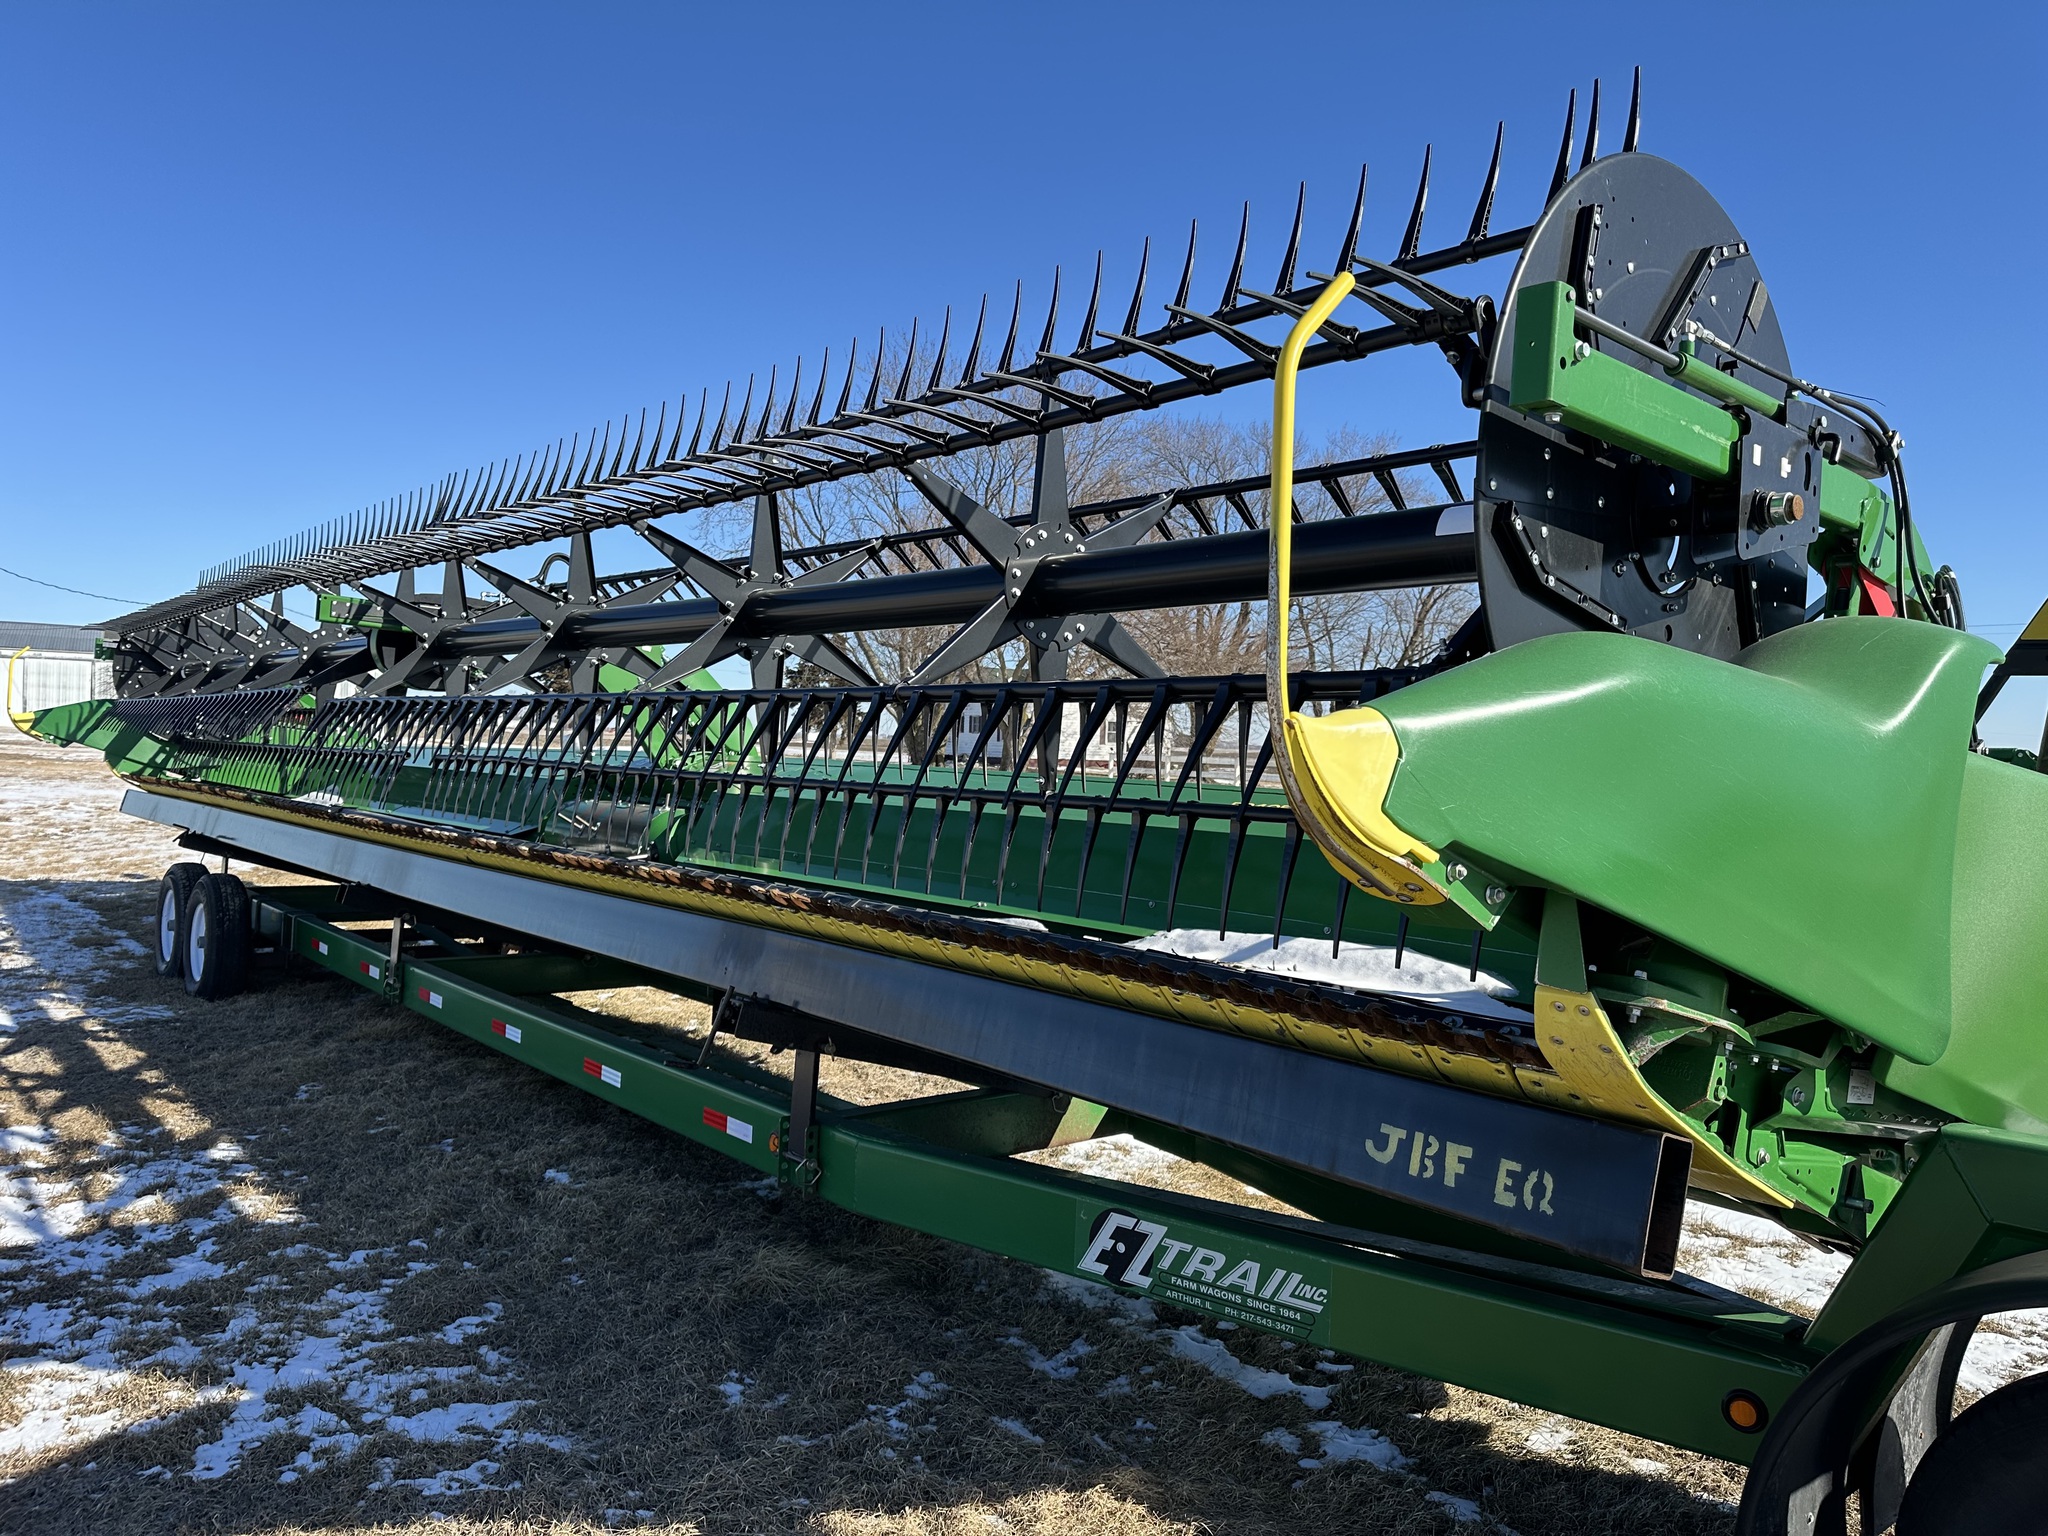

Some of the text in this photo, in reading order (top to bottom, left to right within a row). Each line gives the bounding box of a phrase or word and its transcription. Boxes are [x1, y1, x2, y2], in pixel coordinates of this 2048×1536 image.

[1365, 1122, 1554, 1216] JBF EQ
[1157, 1237, 1324, 1314] TRAIL
[1294, 1283, 1328, 1303] INC.
[1171, 1277, 1301, 1320] FARM WAGONS SINCE 1964
[1205, 1301, 1212, 1310] IL
[1224, 1306, 1239, 1318] PH:
[1240, 1311, 1294, 1334] 217-543-3471
